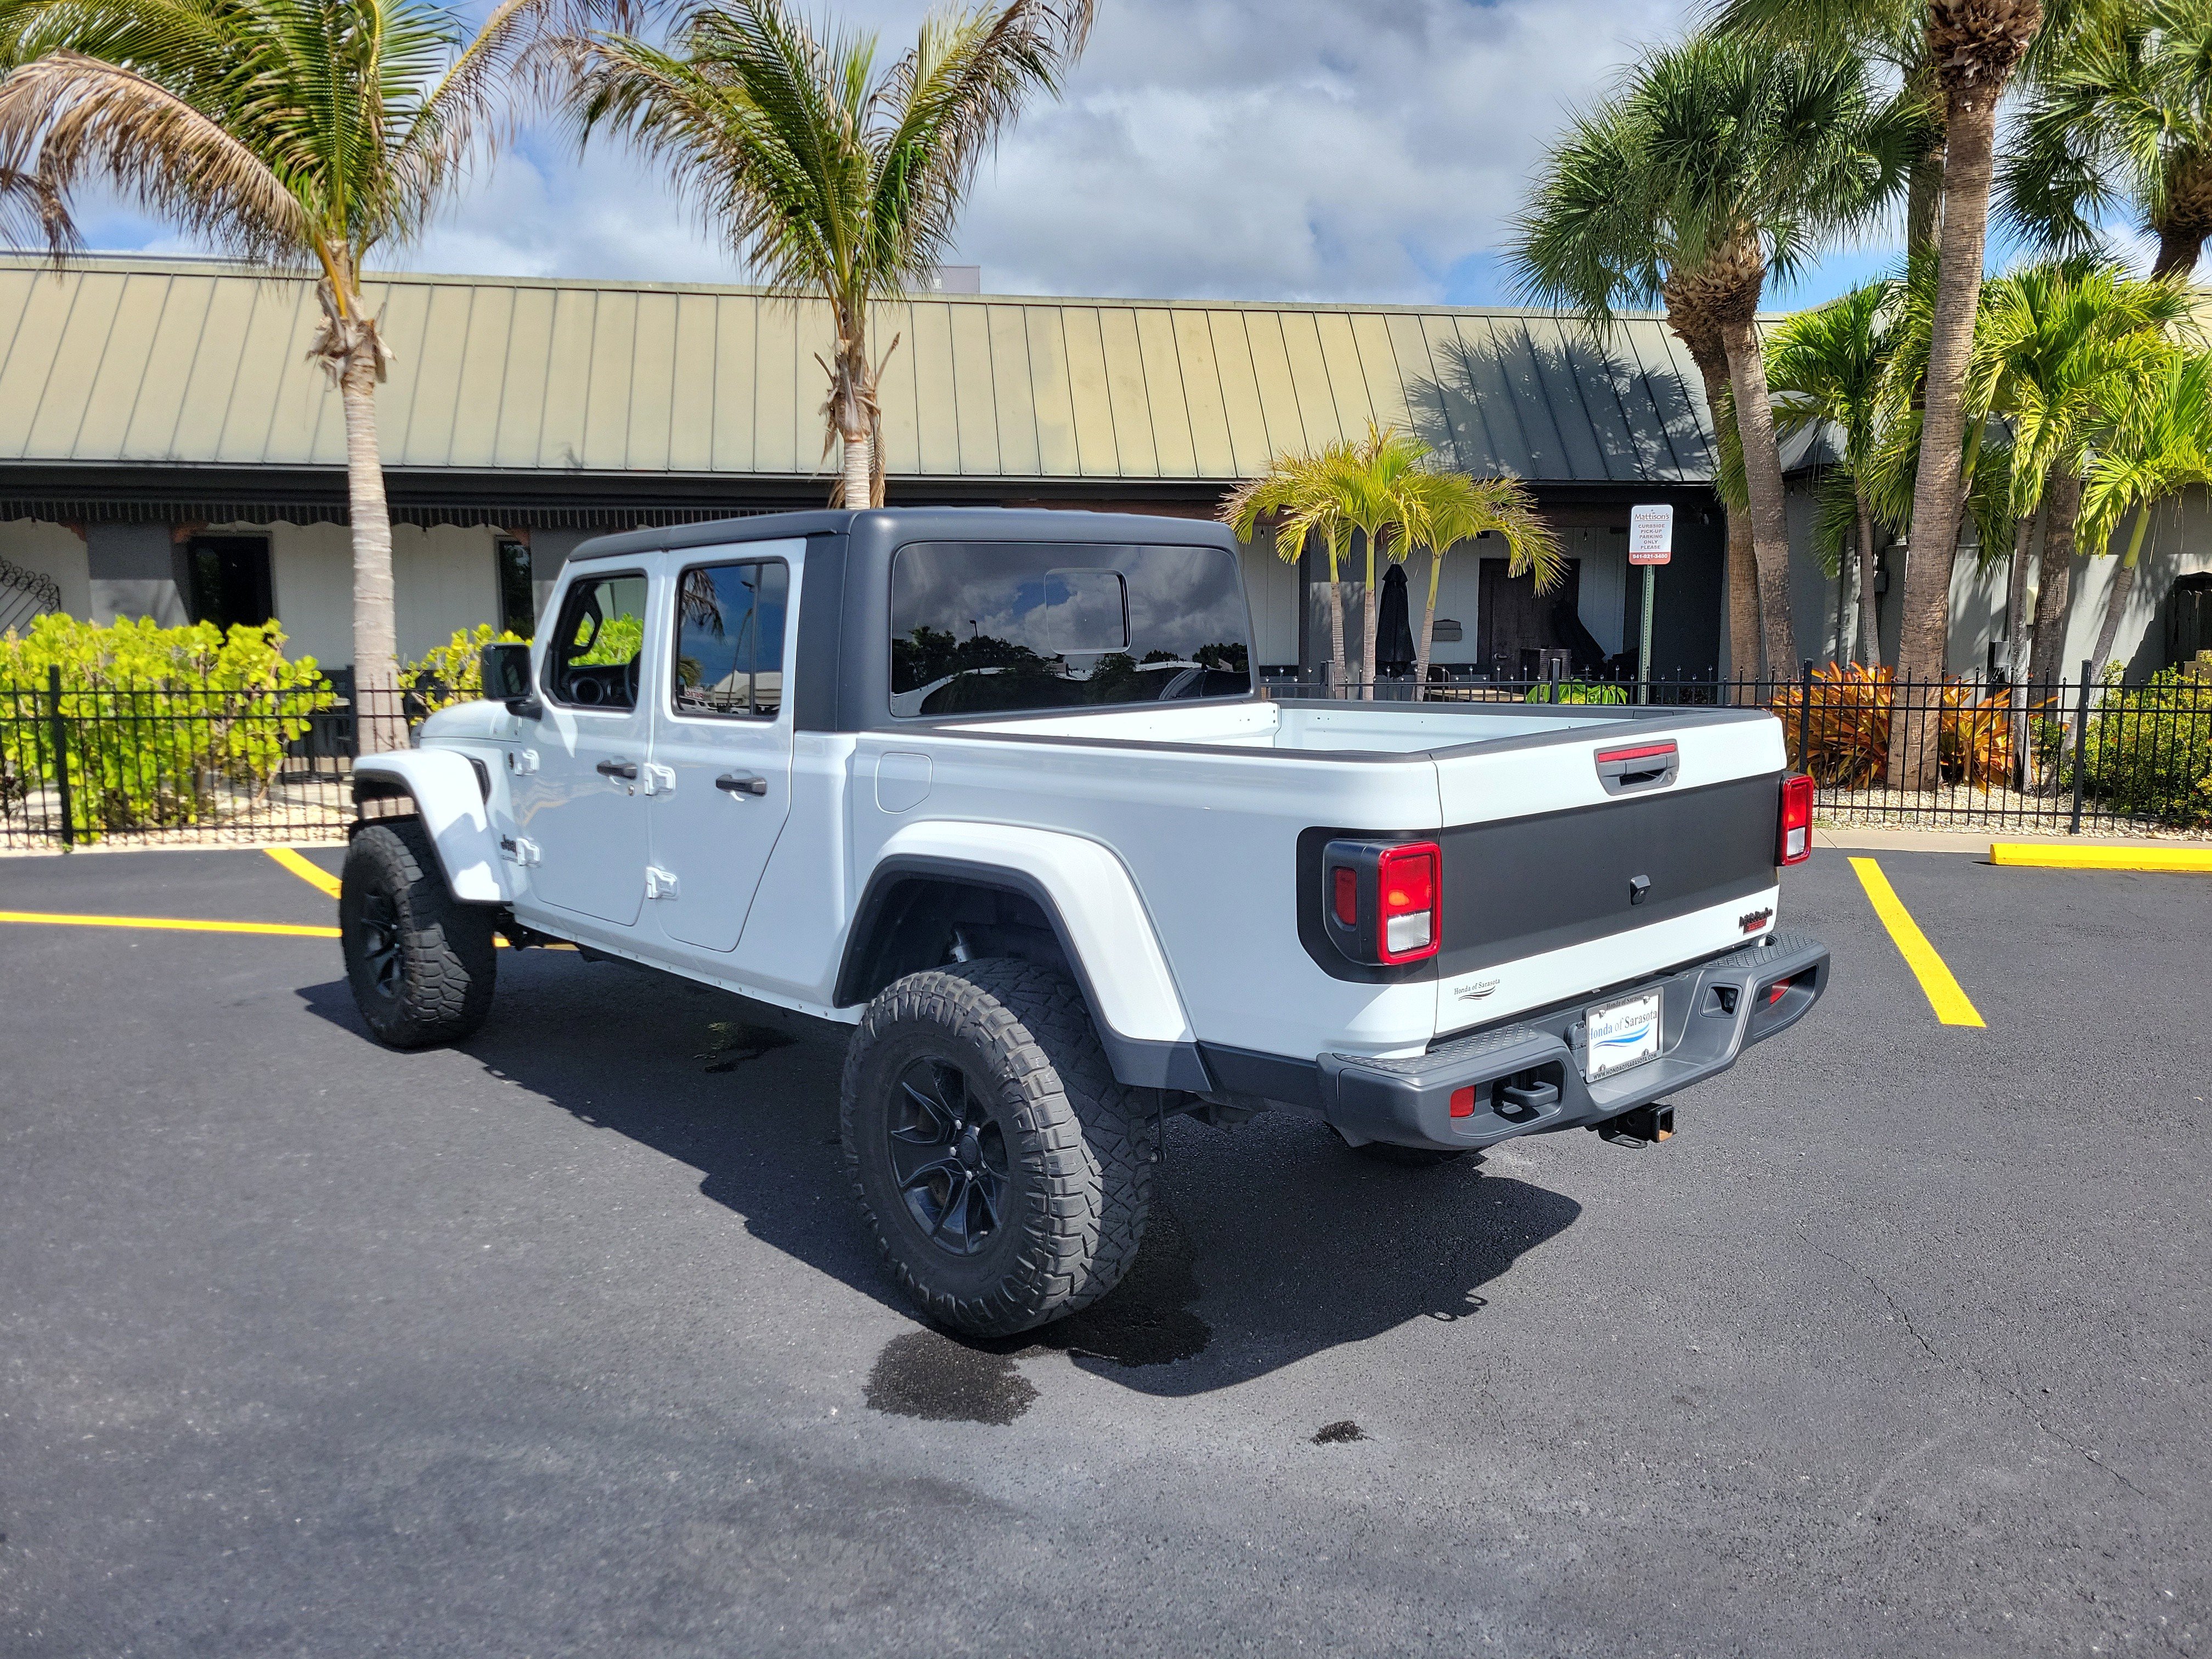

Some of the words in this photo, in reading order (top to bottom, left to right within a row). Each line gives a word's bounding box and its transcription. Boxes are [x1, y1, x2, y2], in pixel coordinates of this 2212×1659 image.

[1454, 985, 1471, 995] Honda
[1478, 979, 1500, 989] Sarasota
[1615, 1018, 1624, 1031] of
[1624, 1009, 1657, 1029] Sarasota
[1593, 1053, 1657, 1080] WWW.HONDAOFSARASOTA.COM
